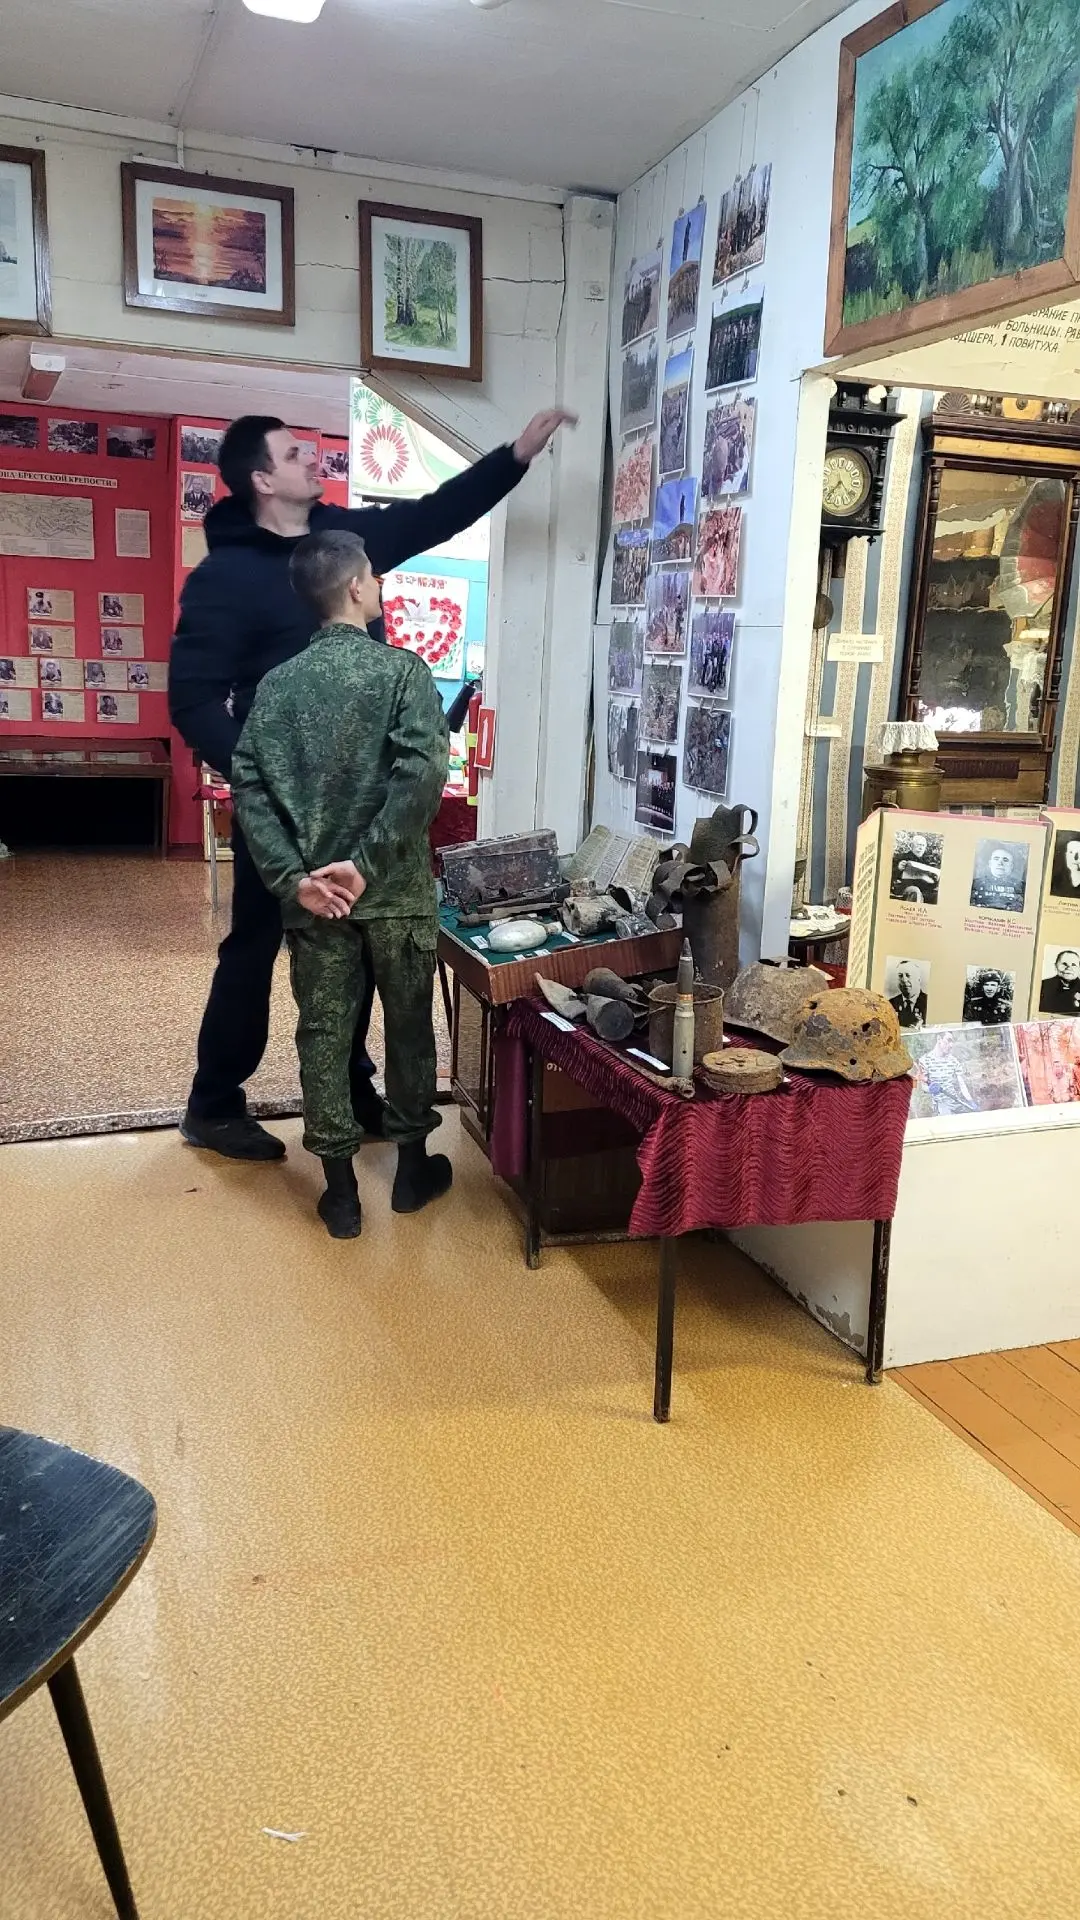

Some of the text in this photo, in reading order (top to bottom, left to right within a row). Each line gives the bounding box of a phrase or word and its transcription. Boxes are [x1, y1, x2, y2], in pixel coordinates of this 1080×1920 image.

[1001, 333, 1008, 346] 1
[1009, 336, 1061, 353] ПОВИТУХА.
[18, 473, 67, 482] БРЕСТСКОЙ
[68, 476, 112, 487] КРЕПОСТИ
